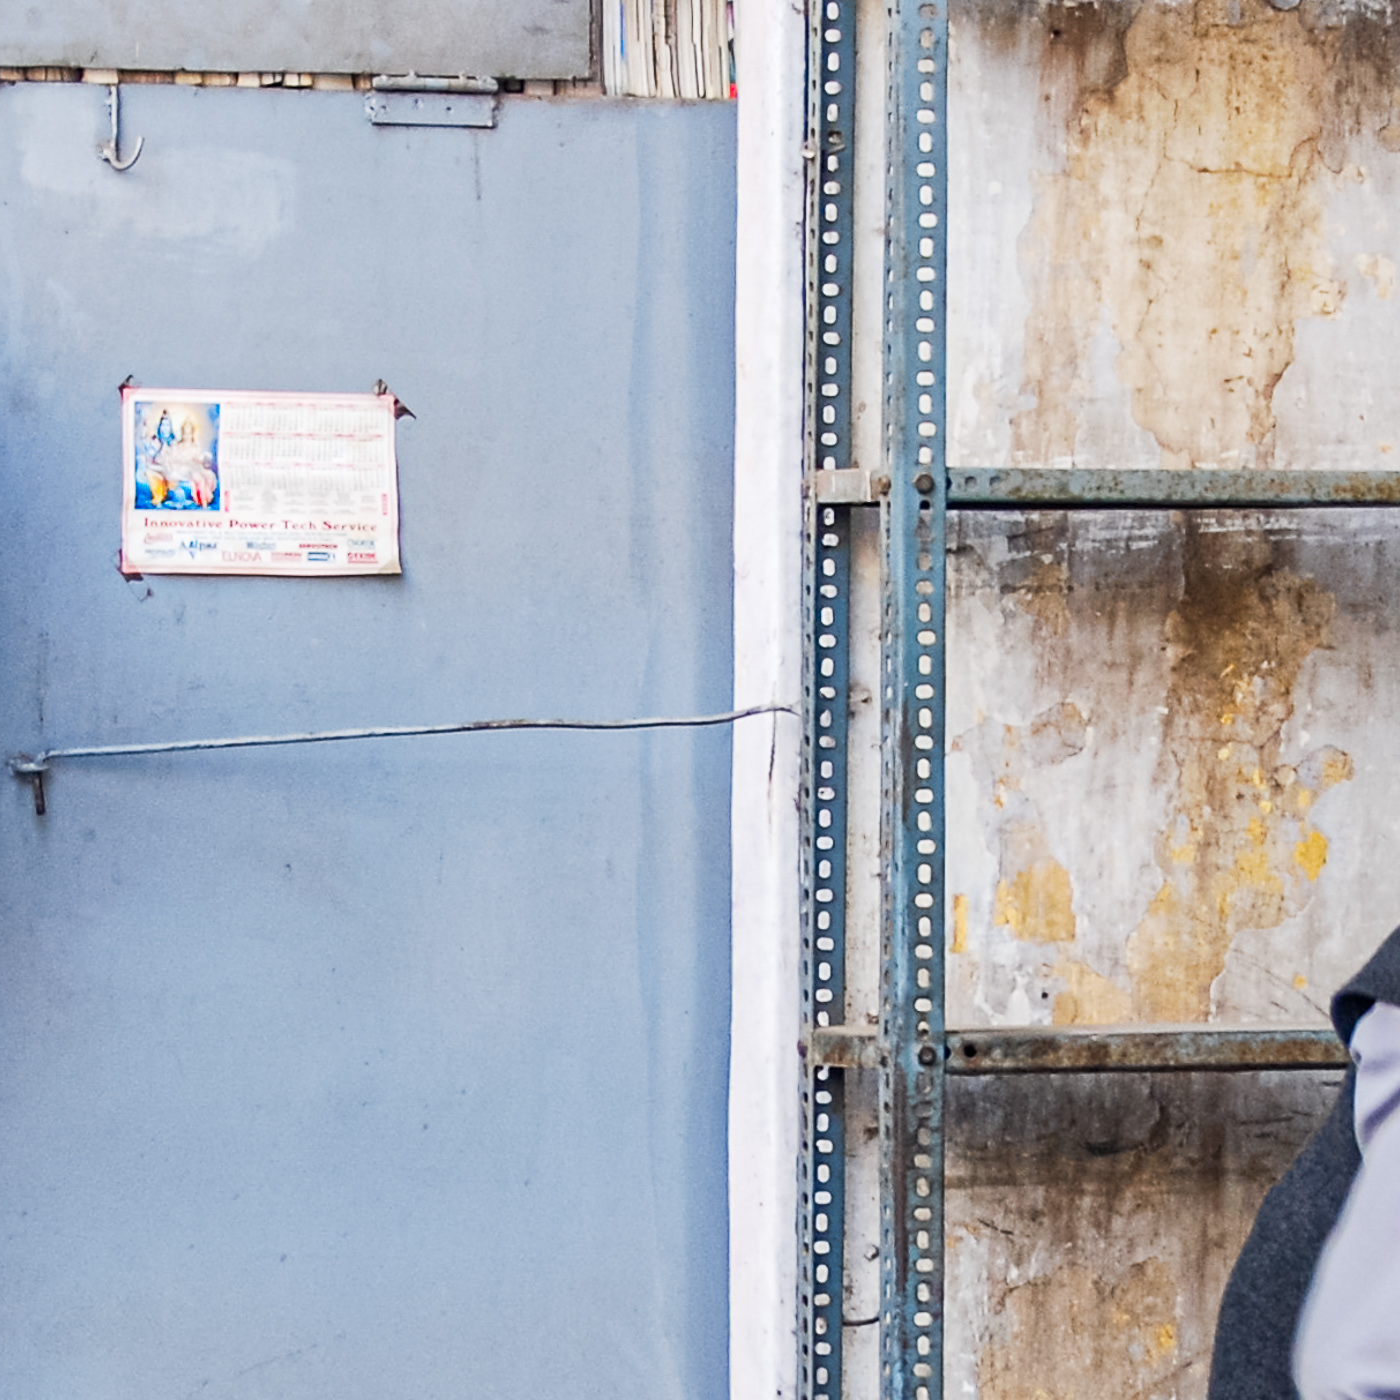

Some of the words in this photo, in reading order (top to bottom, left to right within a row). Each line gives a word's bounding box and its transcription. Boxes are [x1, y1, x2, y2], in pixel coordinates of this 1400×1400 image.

[144, 517, 223, 528] Innovative
[229, 518, 276, 530] Power
[282, 519, 317, 531] Tech
[322, 520, 378, 532] Service
